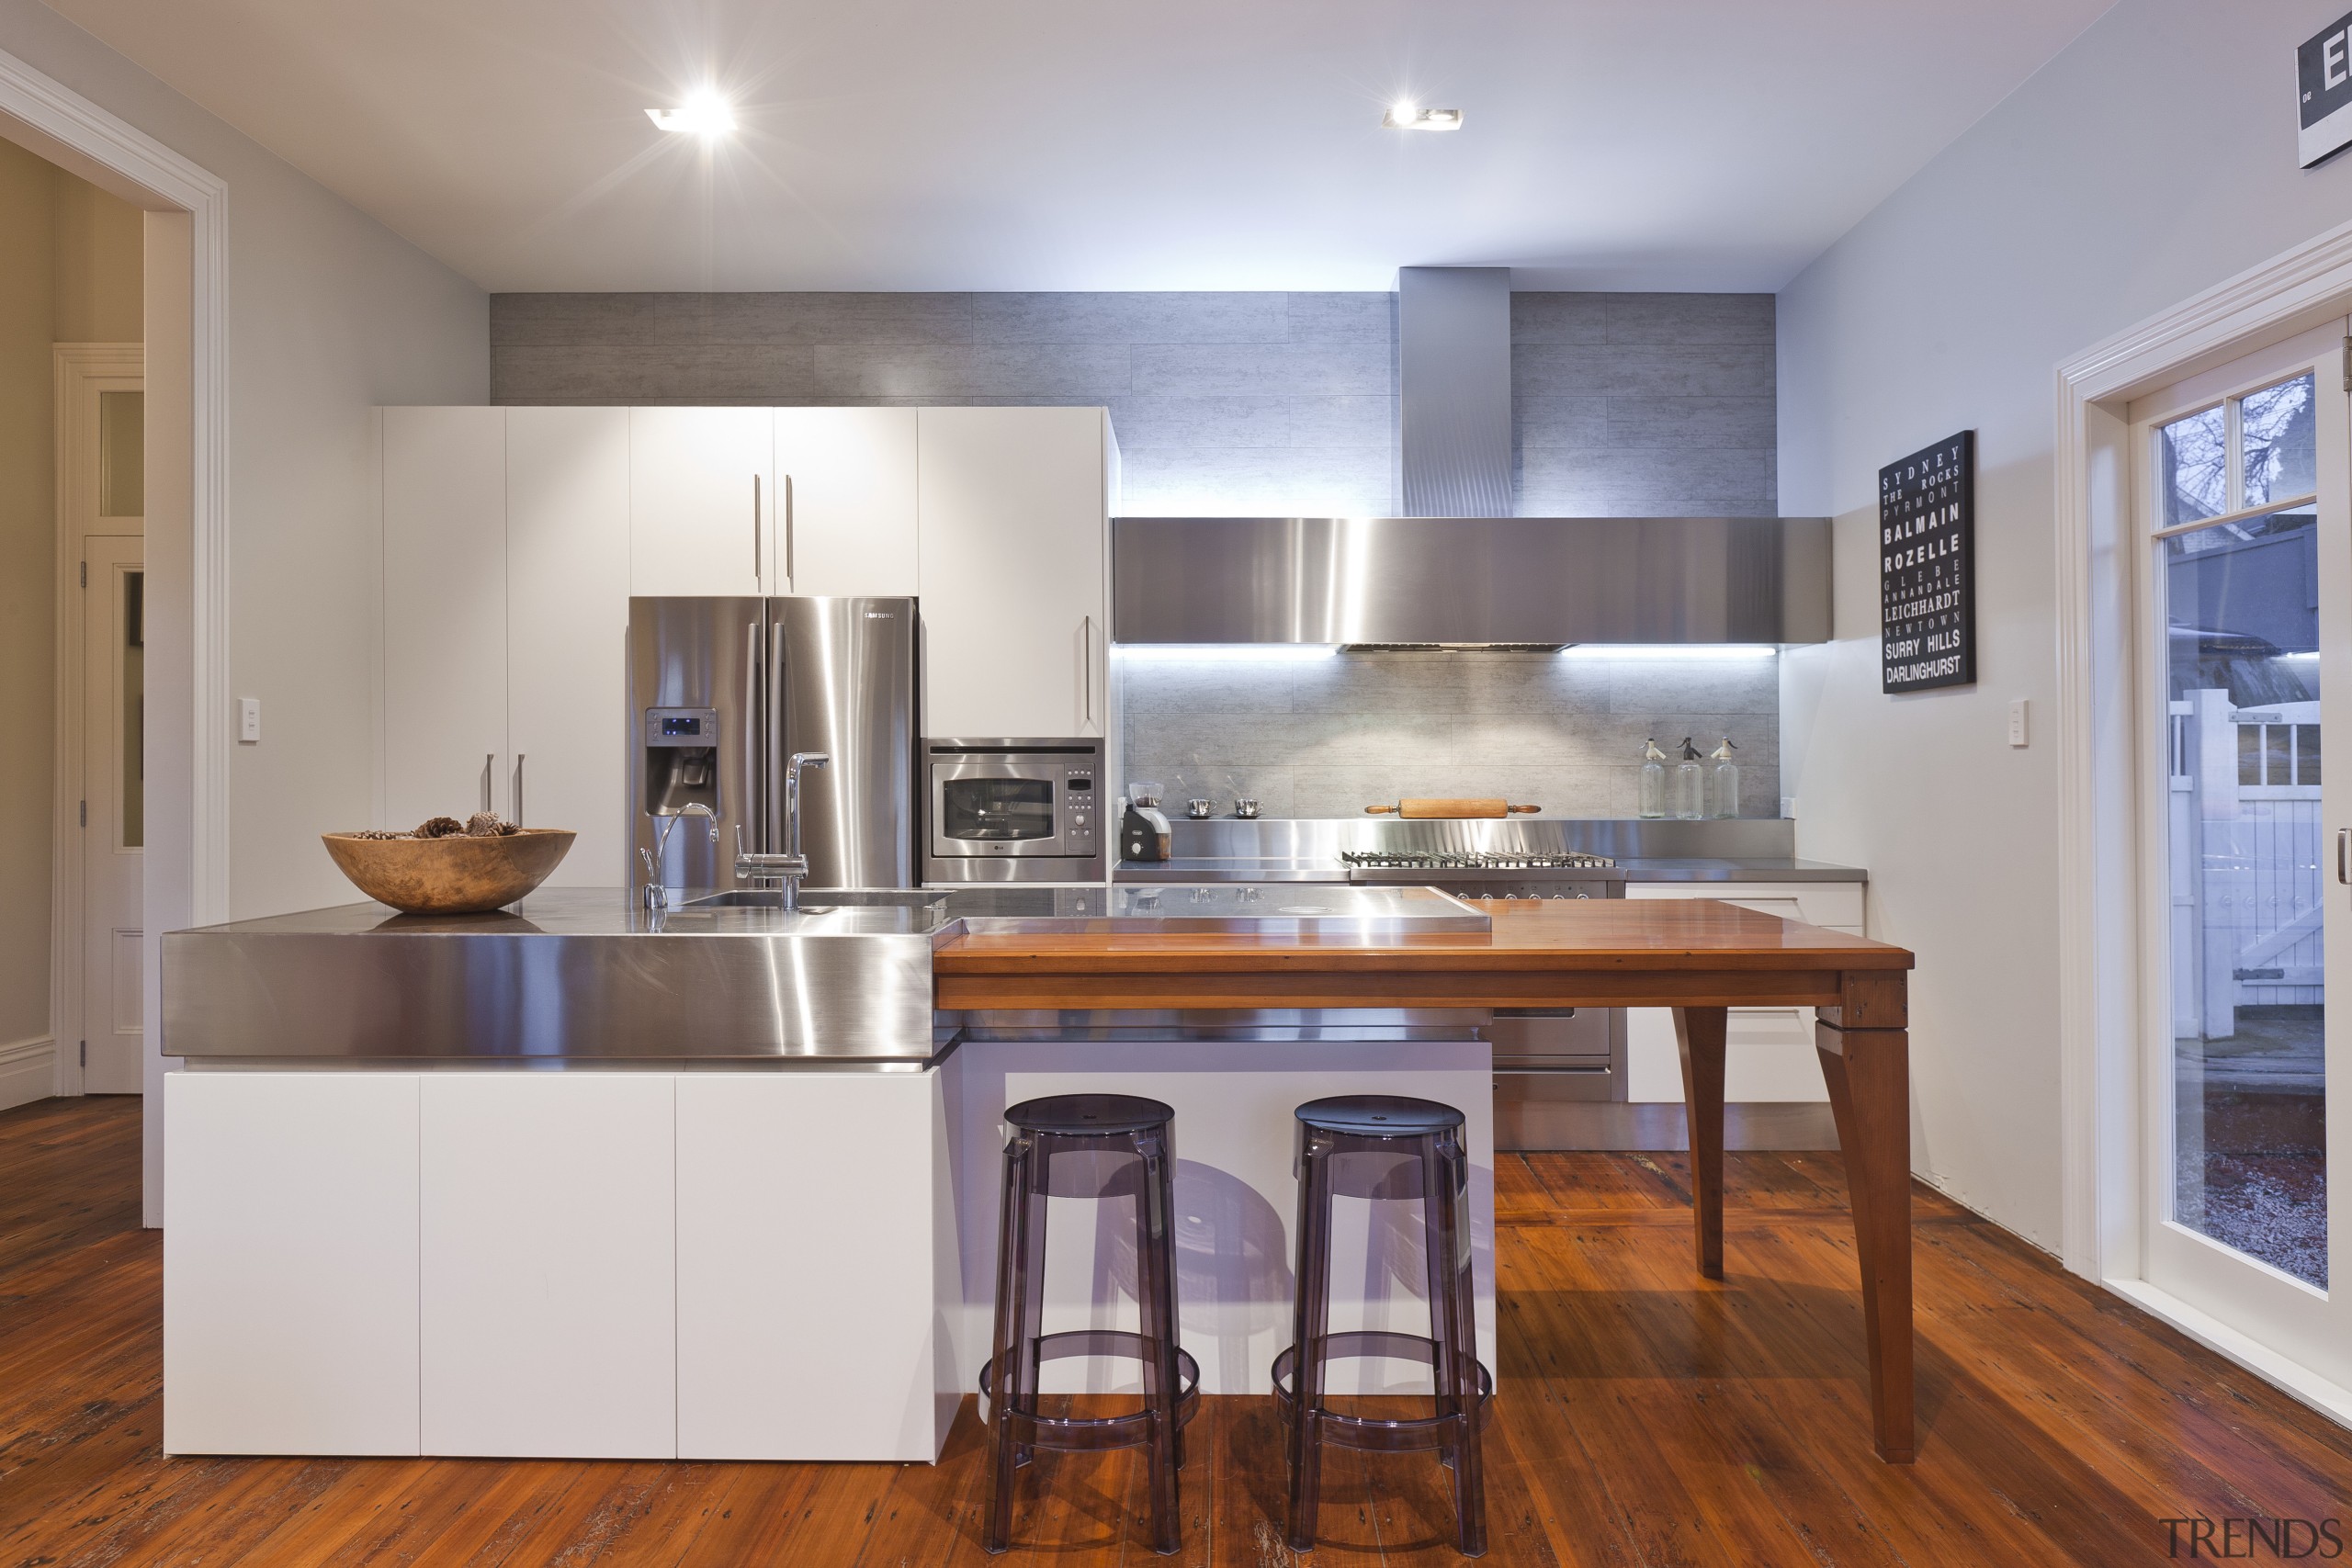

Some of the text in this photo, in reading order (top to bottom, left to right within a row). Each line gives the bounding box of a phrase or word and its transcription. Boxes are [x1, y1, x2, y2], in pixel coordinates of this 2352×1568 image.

[1883, 446, 1959, 491] SYDNEY
[1883, 465, 1959, 505] THE ROCKS
[1883, 480, 1959, 521] PYRMONT
[1884, 502, 1959, 545] BALMAIN
[1884, 534, 1959, 573] ROZELLE
[1884, 558, 1959, 591] GLEBE
[1884, 574, 1960, 604] ANNANDALE
[1885, 590, 1961, 622] LEICHHARDT
[1885, 611, 1960, 638] NEWTOWN
[1885, 629, 1961, 660] SURRY HILLS
[1886, 655, 1961, 683] DARLINGHURST
